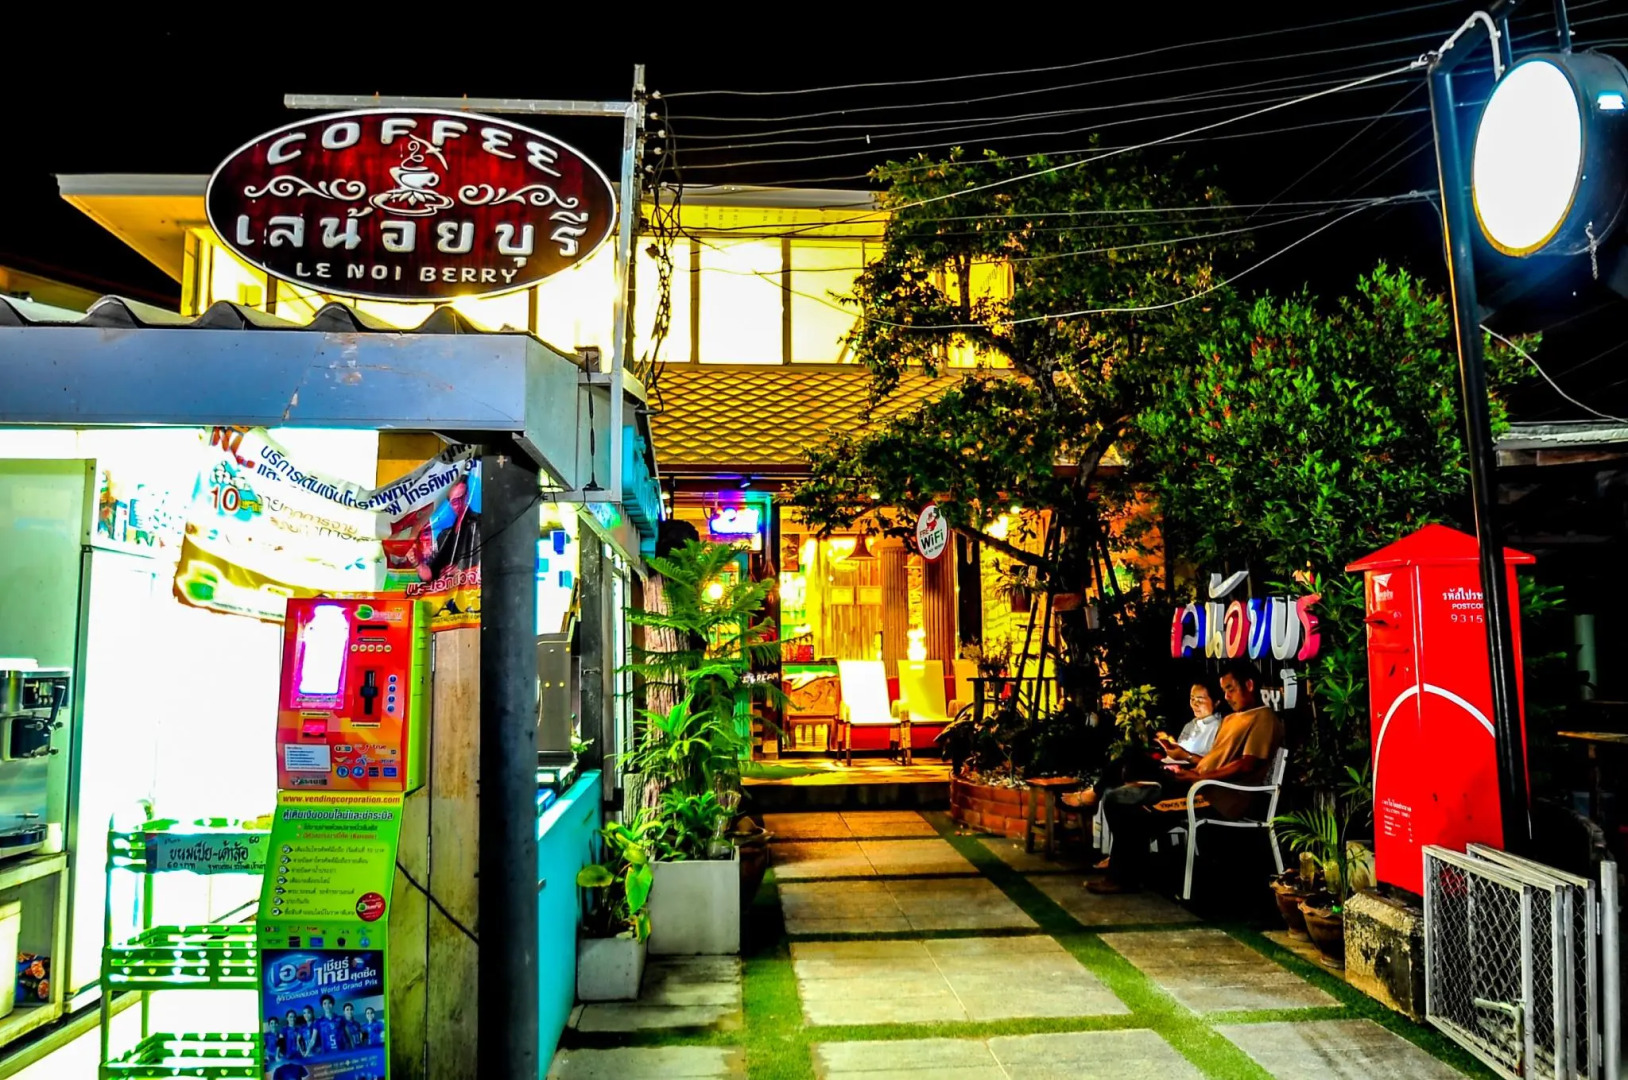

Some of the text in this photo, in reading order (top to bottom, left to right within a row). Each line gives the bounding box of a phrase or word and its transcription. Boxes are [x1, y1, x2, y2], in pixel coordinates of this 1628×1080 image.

[266, 118, 562, 177] COFFEE
[235, 207, 589, 268] เลน้อยบุรี
[296, 262, 518, 284] LE NOI BERRY
[210, 486, 239, 512] 10
[920, 529, 944, 550] WiFi
[282, 794, 400, 805] www.vendingcorporation.com
[320, 985, 340, 994] World
[342, 982, 363, 991] Grand
